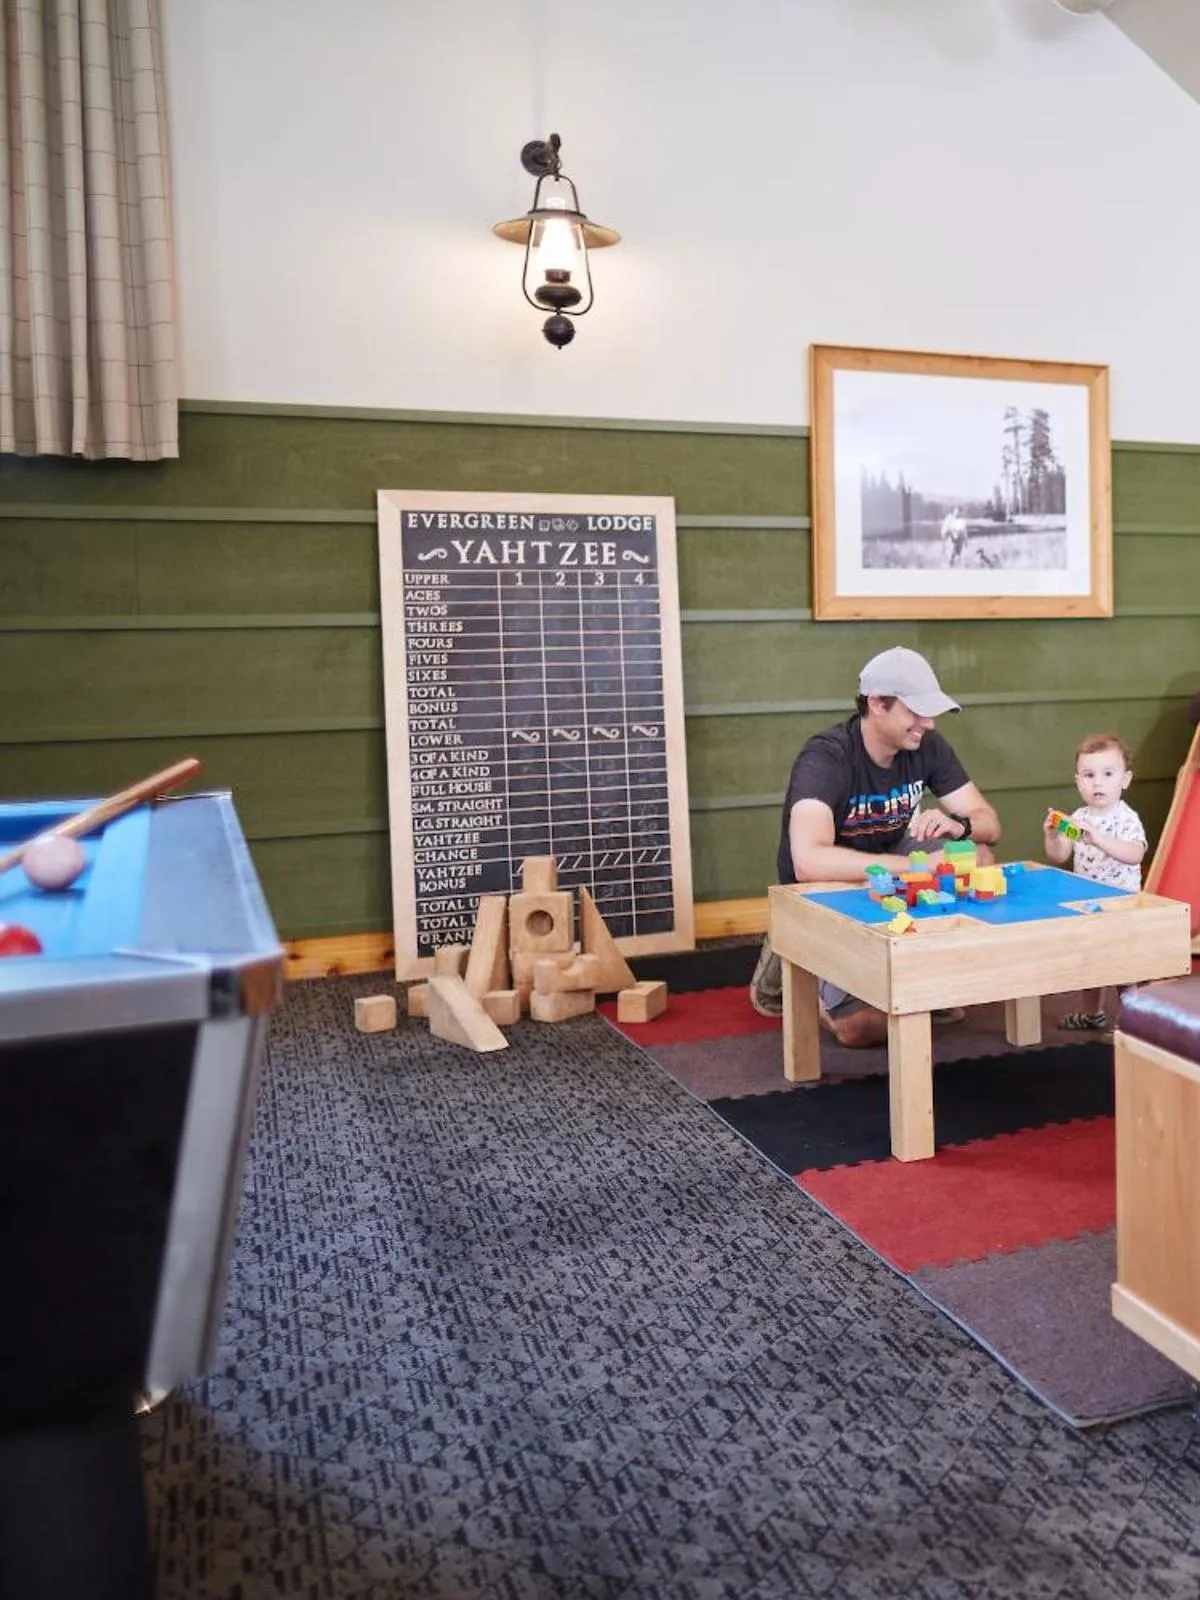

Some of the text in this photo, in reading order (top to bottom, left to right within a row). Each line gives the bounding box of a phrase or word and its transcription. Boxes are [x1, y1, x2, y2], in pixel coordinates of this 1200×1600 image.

[407, 513, 653, 531] EVERGREEN LODGE
[451, 540, 617, 565] YAHTZEE
[405, 571, 644, 586] UPPER 1 2 3 4
[406, 590, 441, 600] ACES
[406, 604, 448, 616] TWOS
[407, 621, 463, 633] THREES
[408, 638, 454, 649] FOURS
[408, 653, 448, 665] FIVES
[407, 670, 448, 681] SIXES
[409, 686, 456, 698] TOTAL
[409, 702, 458, 714] BONUS
[410, 718, 457, 731] TOTAL
[410, 734, 463, 747] LOWER
[419, 752, 436, 764] OF
[438, 751, 448, 762] A
[450, 750, 489, 762] KIND
[411, 766, 490, 780] 4 OF A KIND
[411, 781, 492, 797] FULL HOUSE
[412, 798, 503, 813] SM. STRAIGHT
[435, 814, 502, 829] STRAIGHT
[415, 832, 480, 847] YAHTZEE
[415, 848, 478, 863] CHANCE
[416, 864, 483, 880] YAHTZEE
[419, 878, 466, 893] BONUS
[420, 899, 465, 913] TOTAL
[420, 916, 468, 930] TOTAL
